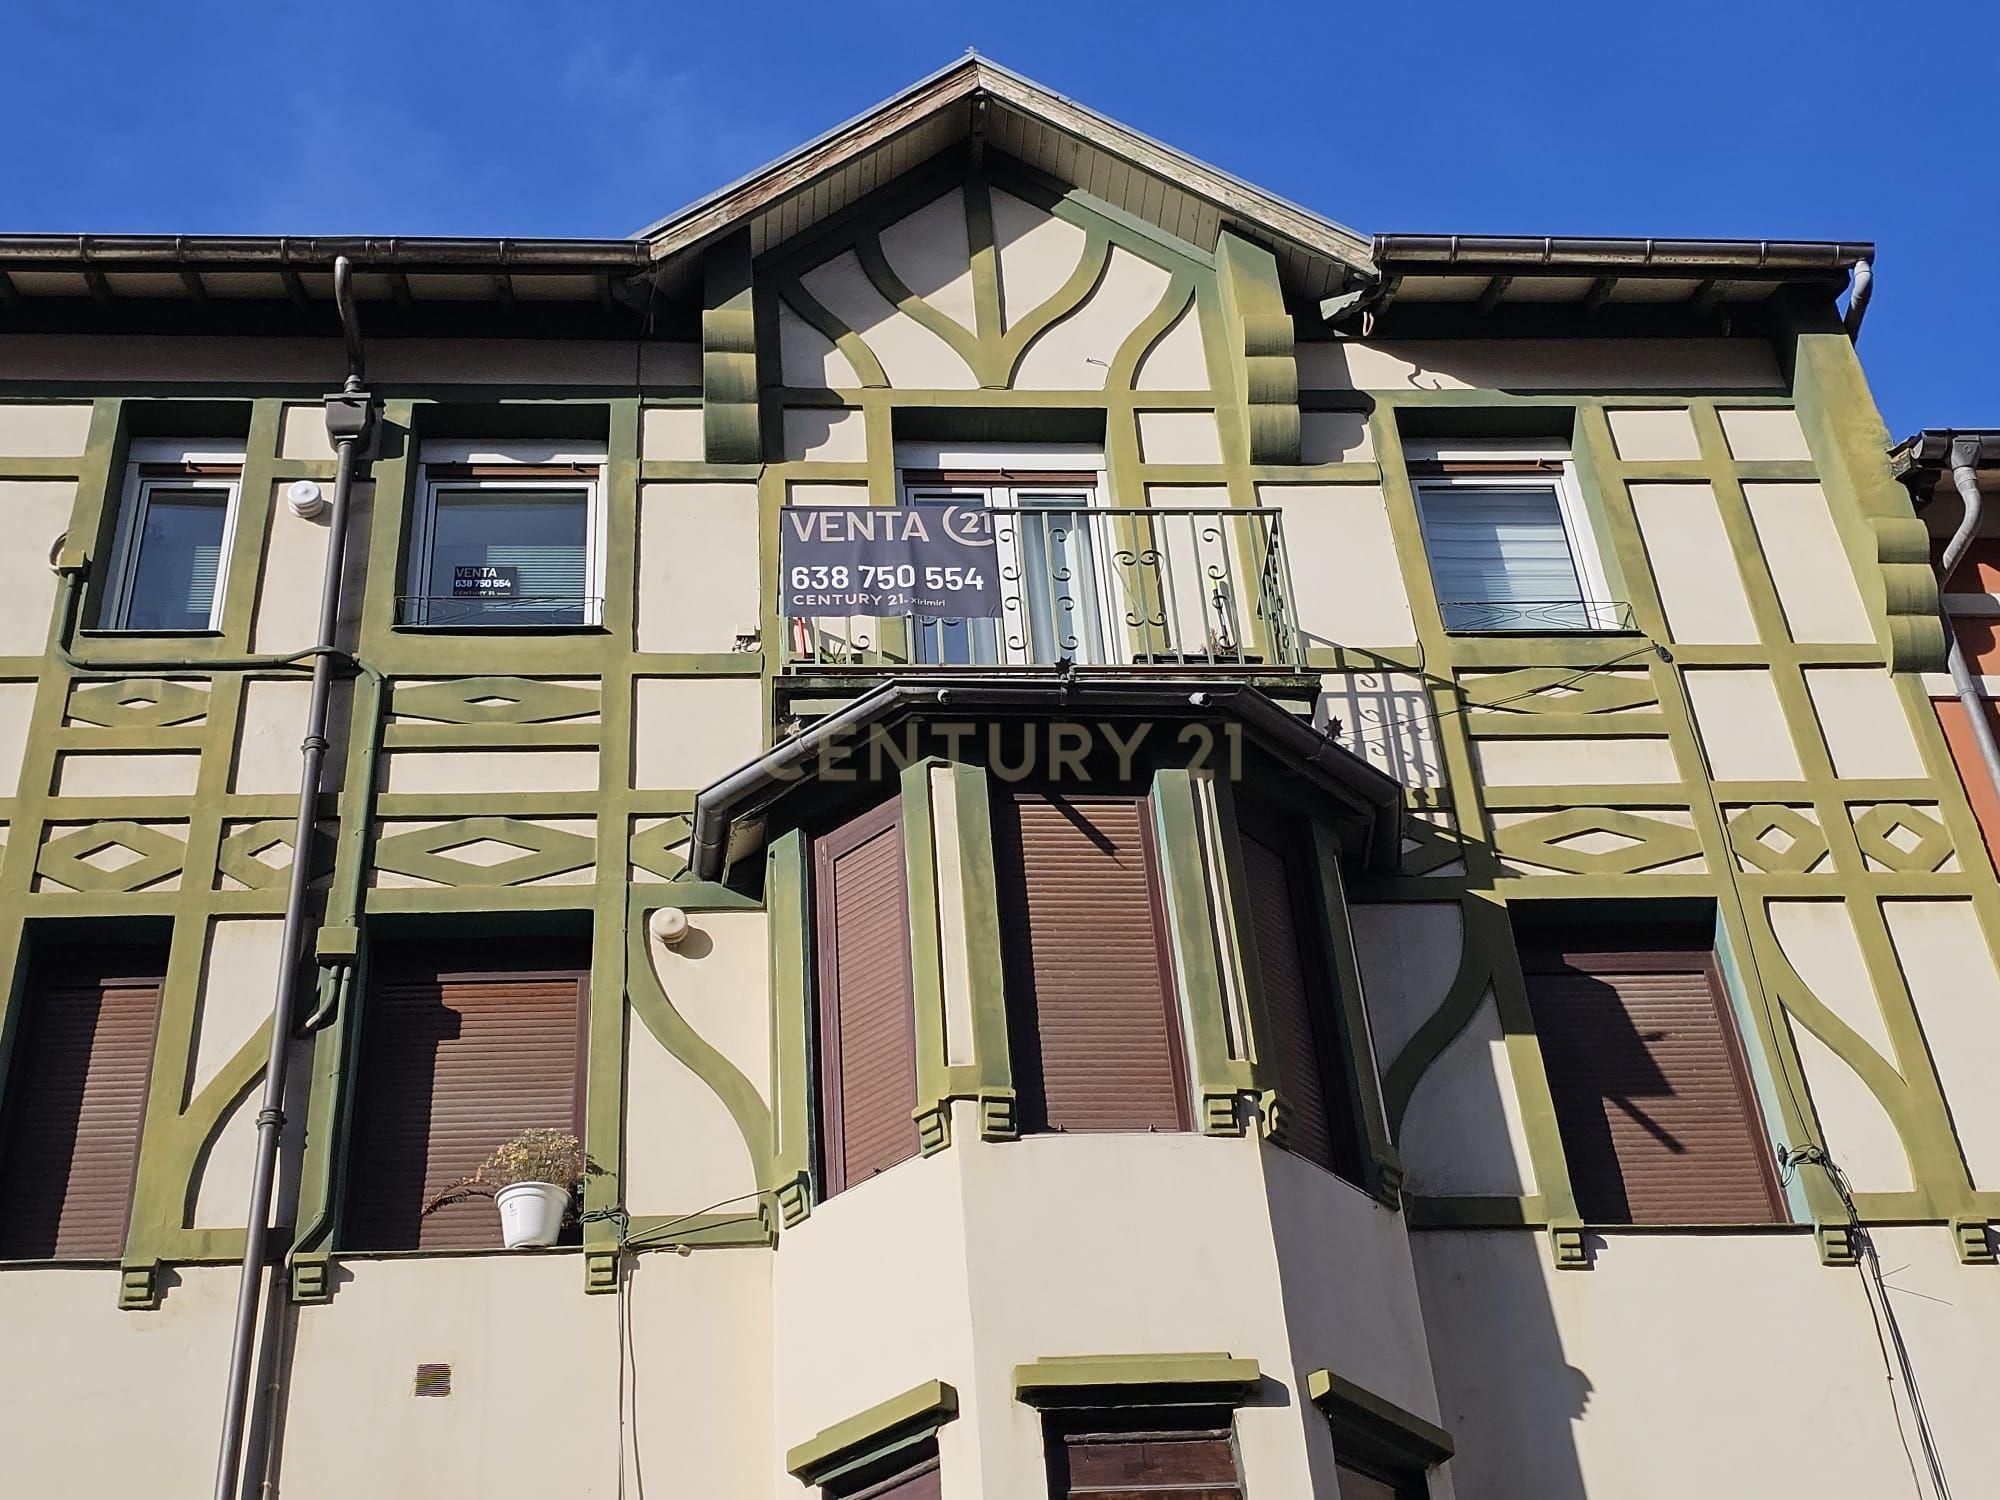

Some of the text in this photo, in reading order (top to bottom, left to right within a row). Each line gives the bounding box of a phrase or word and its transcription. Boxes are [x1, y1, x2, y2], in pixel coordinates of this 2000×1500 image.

[789, 511, 930, 542] VENTA
[456, 568, 497, 578] VENTA
[791, 564, 984, 591] 638 750 554
[455, 579, 473, 588] 638
[474, 579, 492, 588] 750
[792, 593, 882, 607] CENTURY
